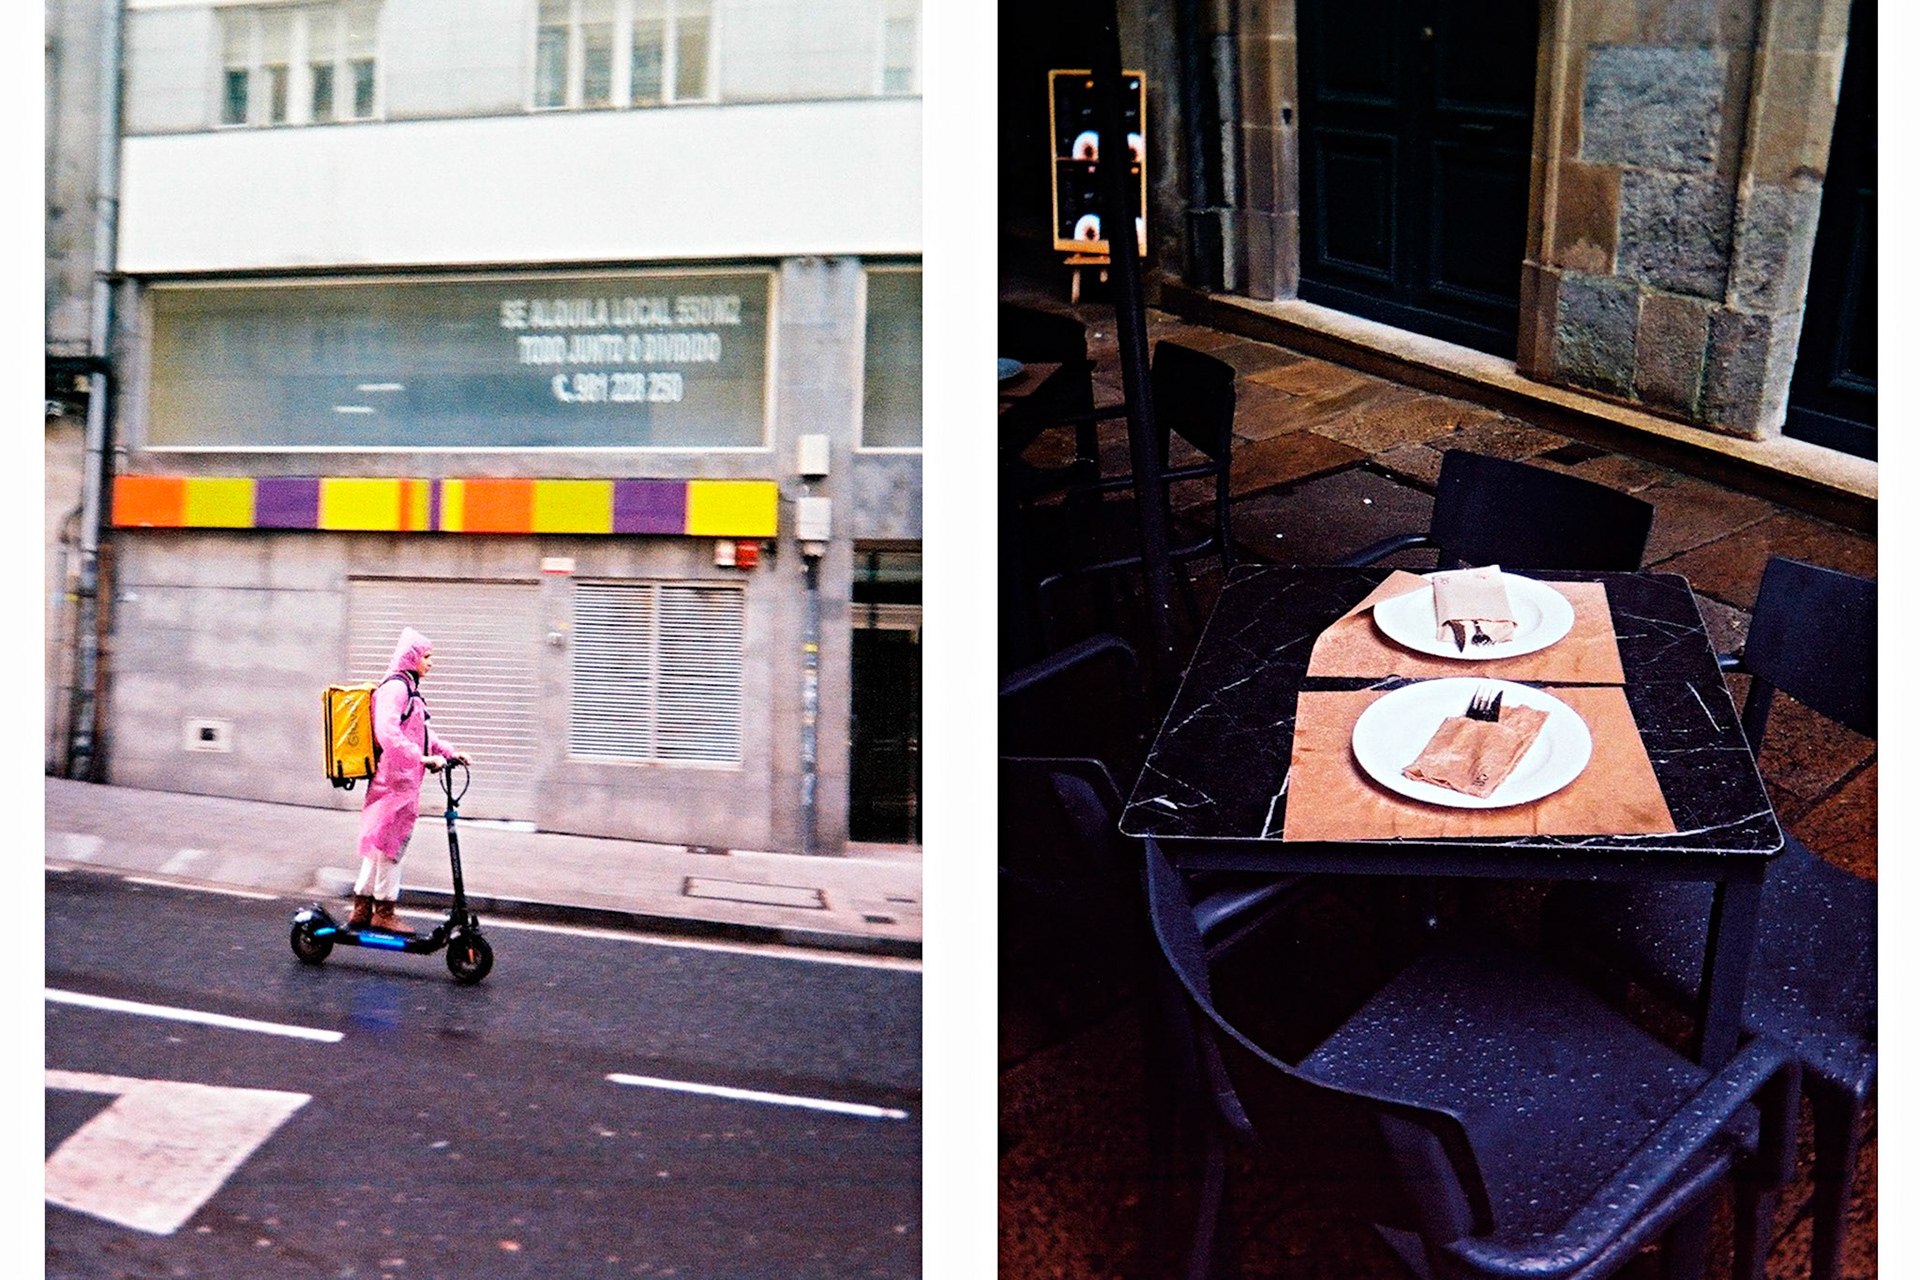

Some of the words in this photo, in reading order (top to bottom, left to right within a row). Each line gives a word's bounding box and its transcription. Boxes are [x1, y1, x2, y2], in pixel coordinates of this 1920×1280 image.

[500, 299, 528, 329] SE
[528, 298, 609, 328] ALQUILA
[612, 297, 672, 327] LOCAL
[517, 335, 566, 365] TODO
[568, 334, 625, 363] JUNTO
[642, 332, 722, 362] DIVIDIDO
